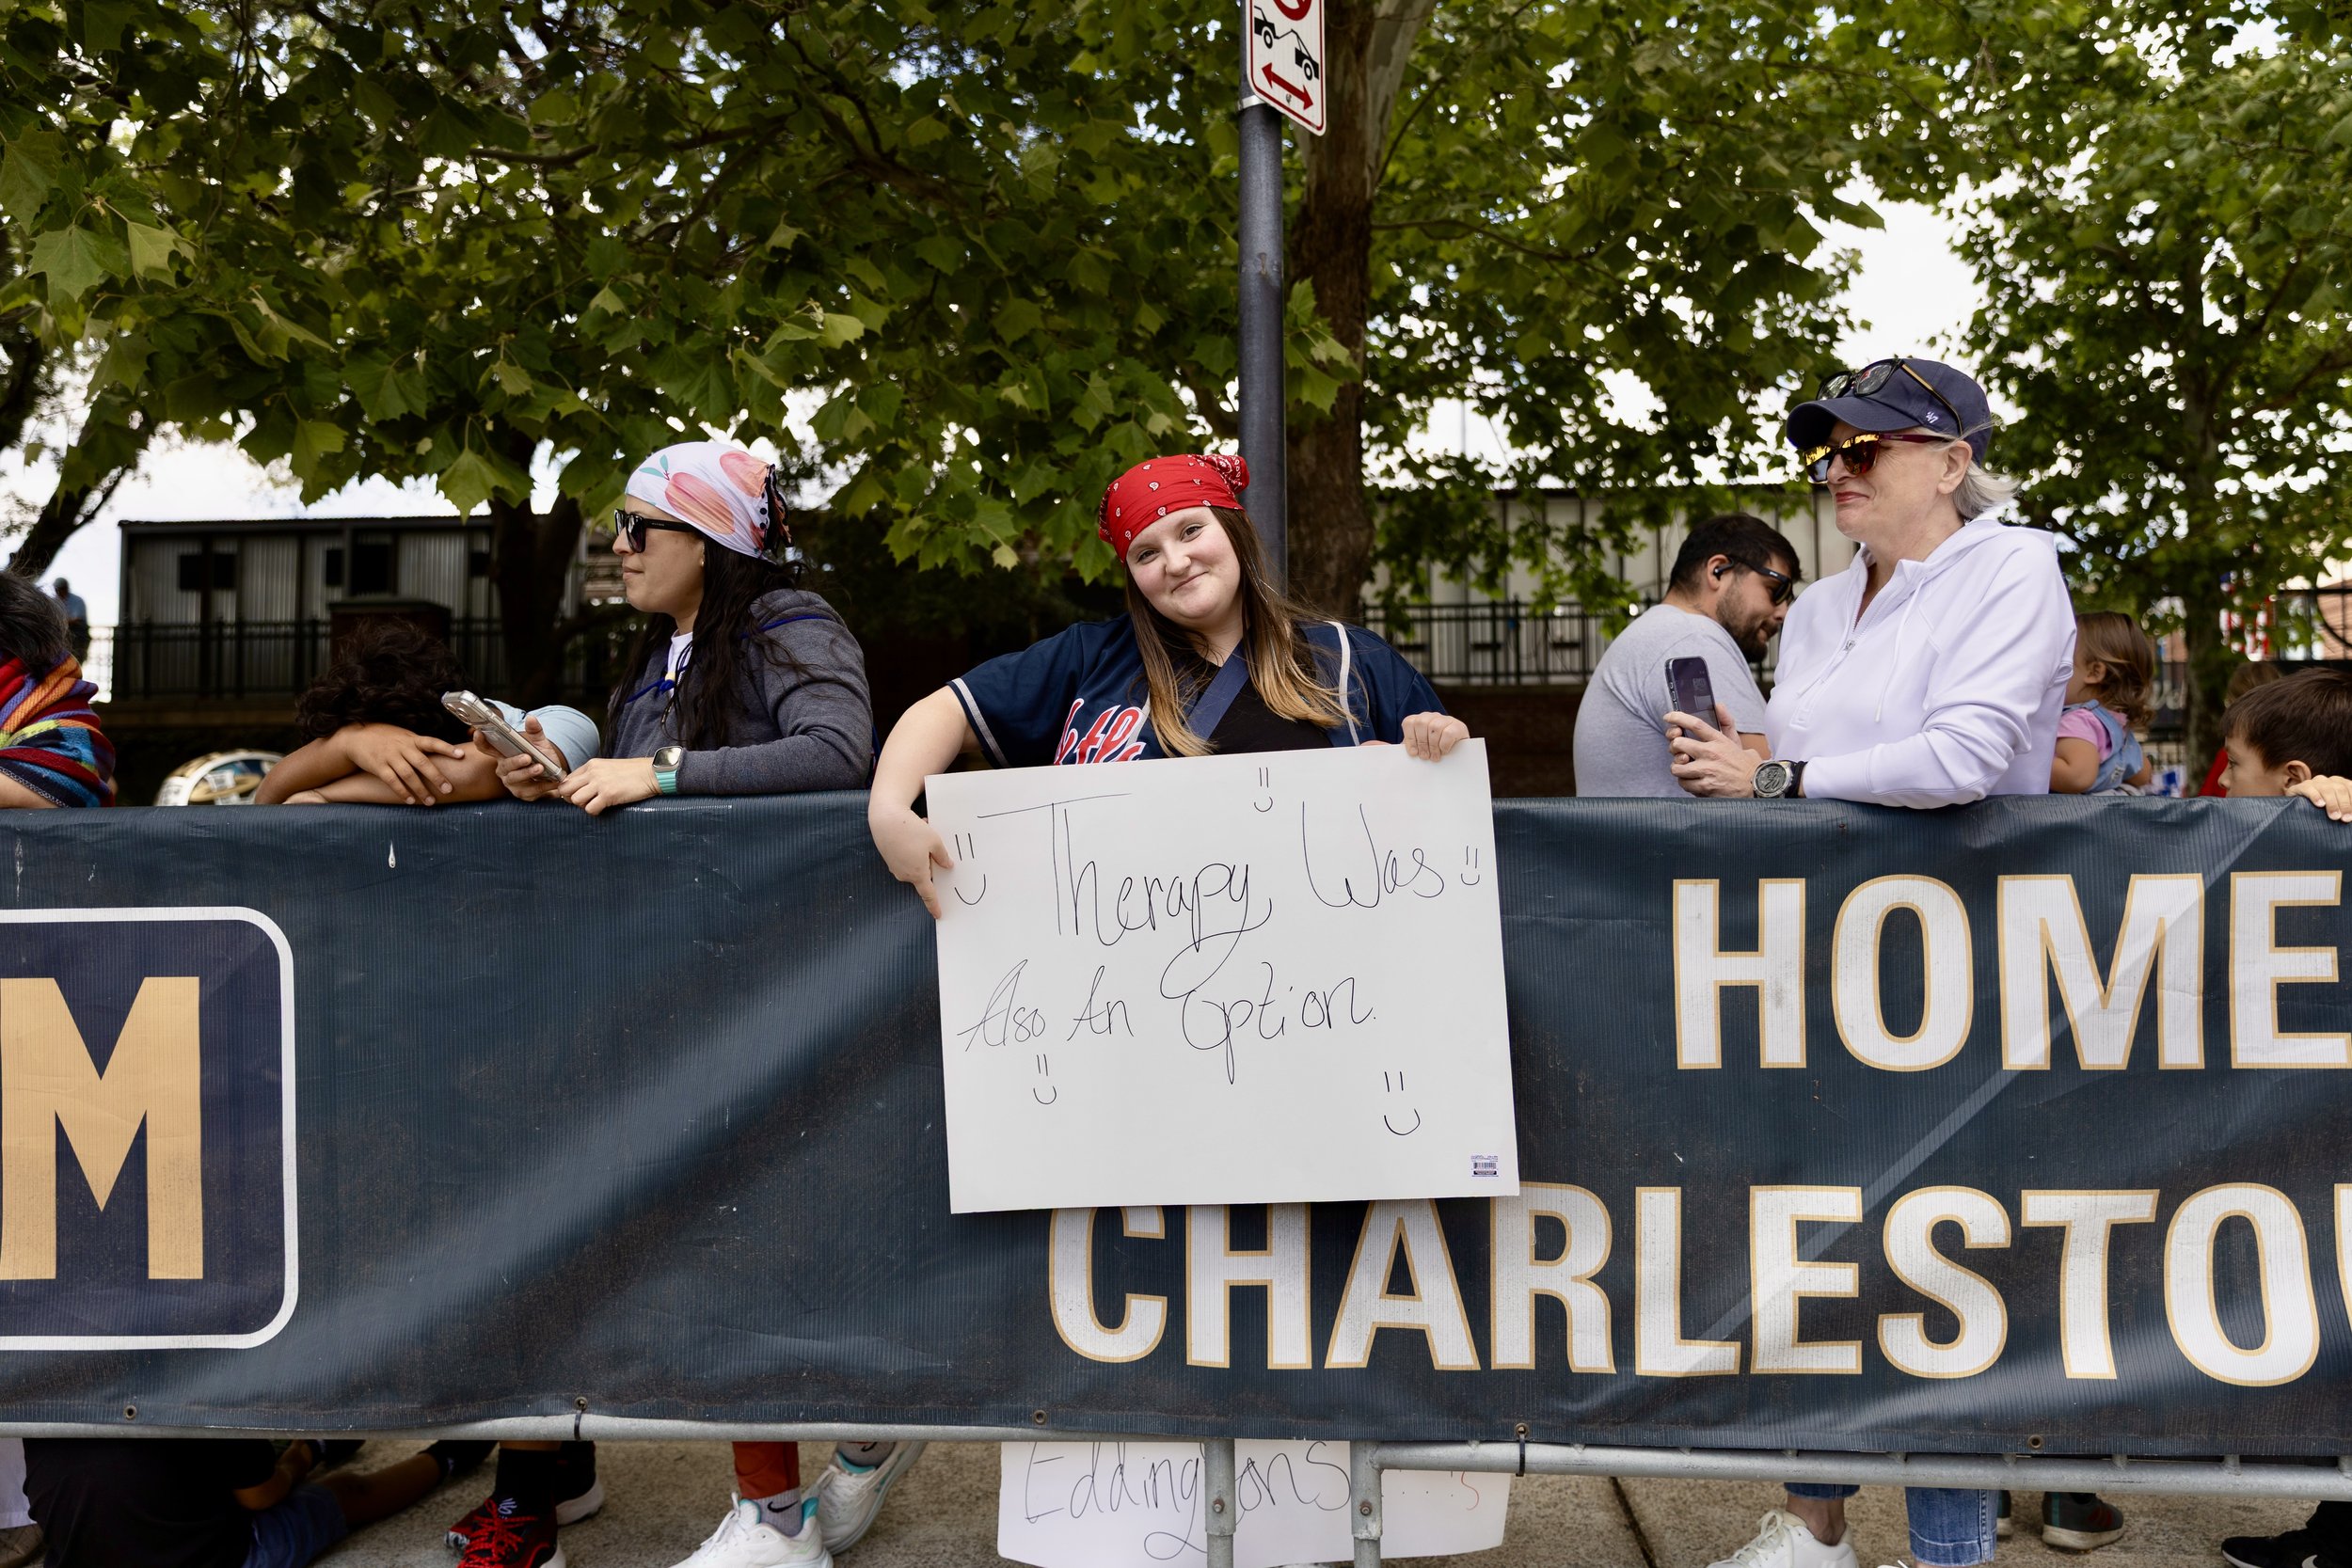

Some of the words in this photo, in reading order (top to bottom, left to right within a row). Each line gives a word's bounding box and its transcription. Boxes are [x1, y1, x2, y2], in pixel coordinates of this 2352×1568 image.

[977, 792, 1273, 999] Therapy
[1302, 800, 1445, 909] Was
[1672, 870, 2352, 1071] HOME
[956, 958, 1046, 1053] Also
[1066, 965, 1135, 1042] An
[0, 976, 203, 1279] M
[1048, 1181, 2352, 1386] CHARLESTO
[1025, 1441, 1351, 1561] Eddingons
